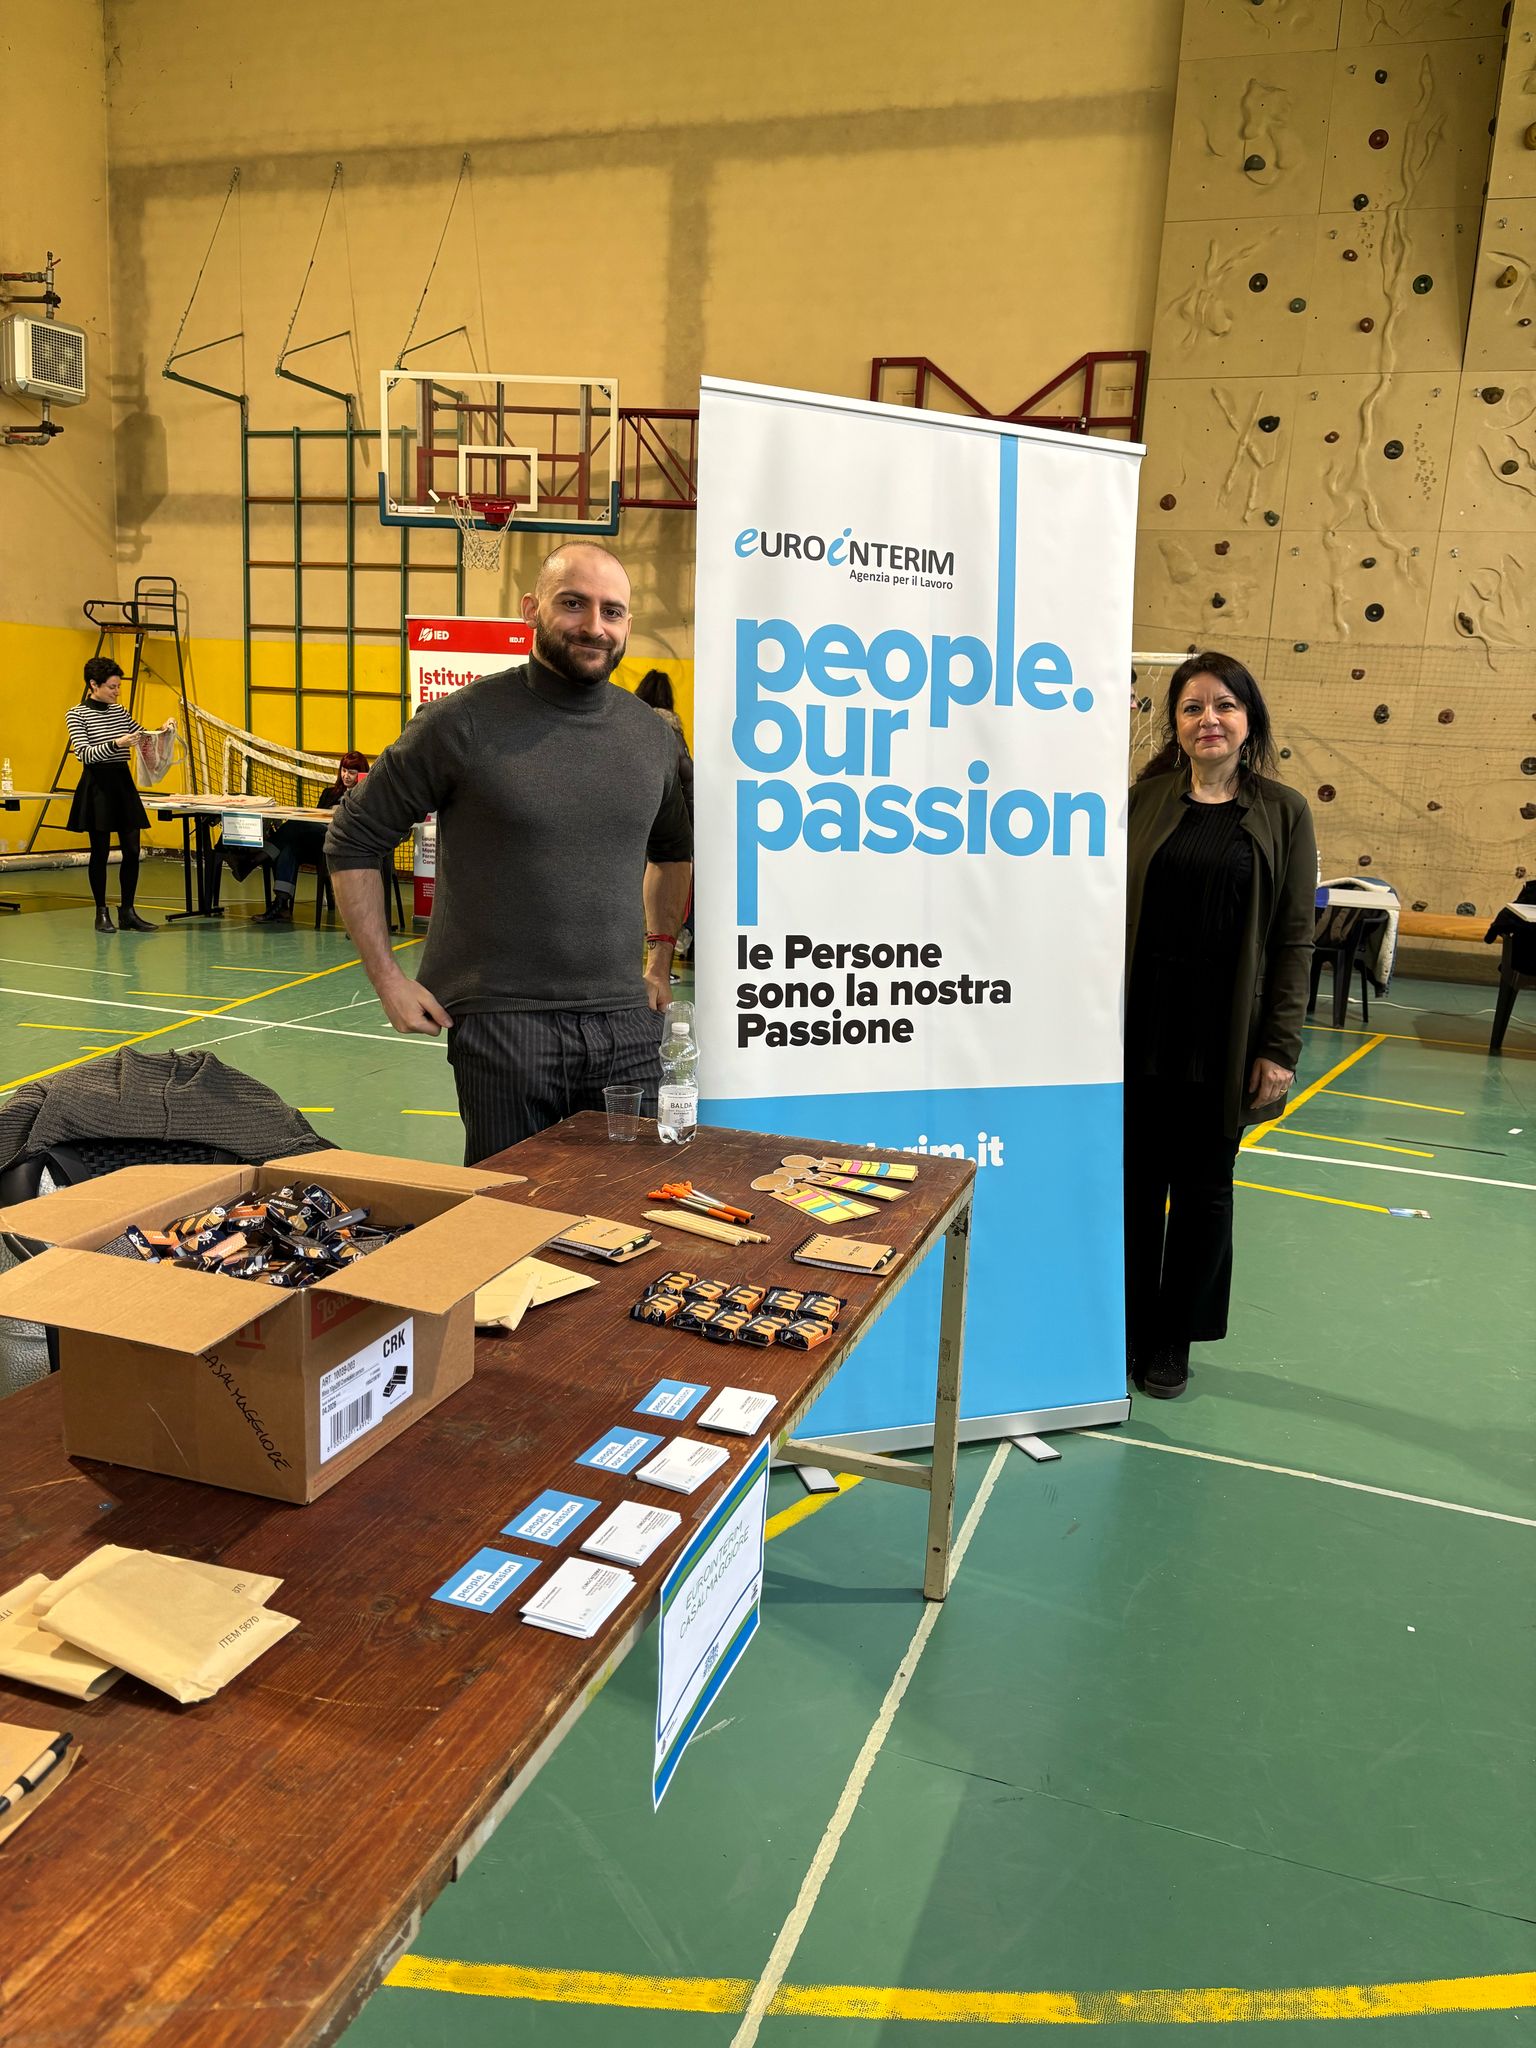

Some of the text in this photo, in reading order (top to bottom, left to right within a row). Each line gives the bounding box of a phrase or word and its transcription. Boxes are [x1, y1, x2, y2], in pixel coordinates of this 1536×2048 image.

[850, 569, 954, 590] Agenzia per il Lavoro
[433, 630, 450, 641] IED
[508, 636, 526, 644] IED.IT
[732, 699, 909, 777] our
[736, 760, 1106, 926] passion
[737, 934, 943, 970] le Persone
[736, 973, 1012, 1009] sono la nostra
[737, 1009, 915, 1049] Passione
[382, 1327, 406, 1358] CRK
[201, 1348, 293, 1472] ASALMAGGIORE
[456, 1573, 487, 1599] people.
[474, 1564, 516, 1603] our passion
[679, 1524, 750, 1640] CASALMAGGIORE
[218, 1615, 260, 1649] ITEM 5670
